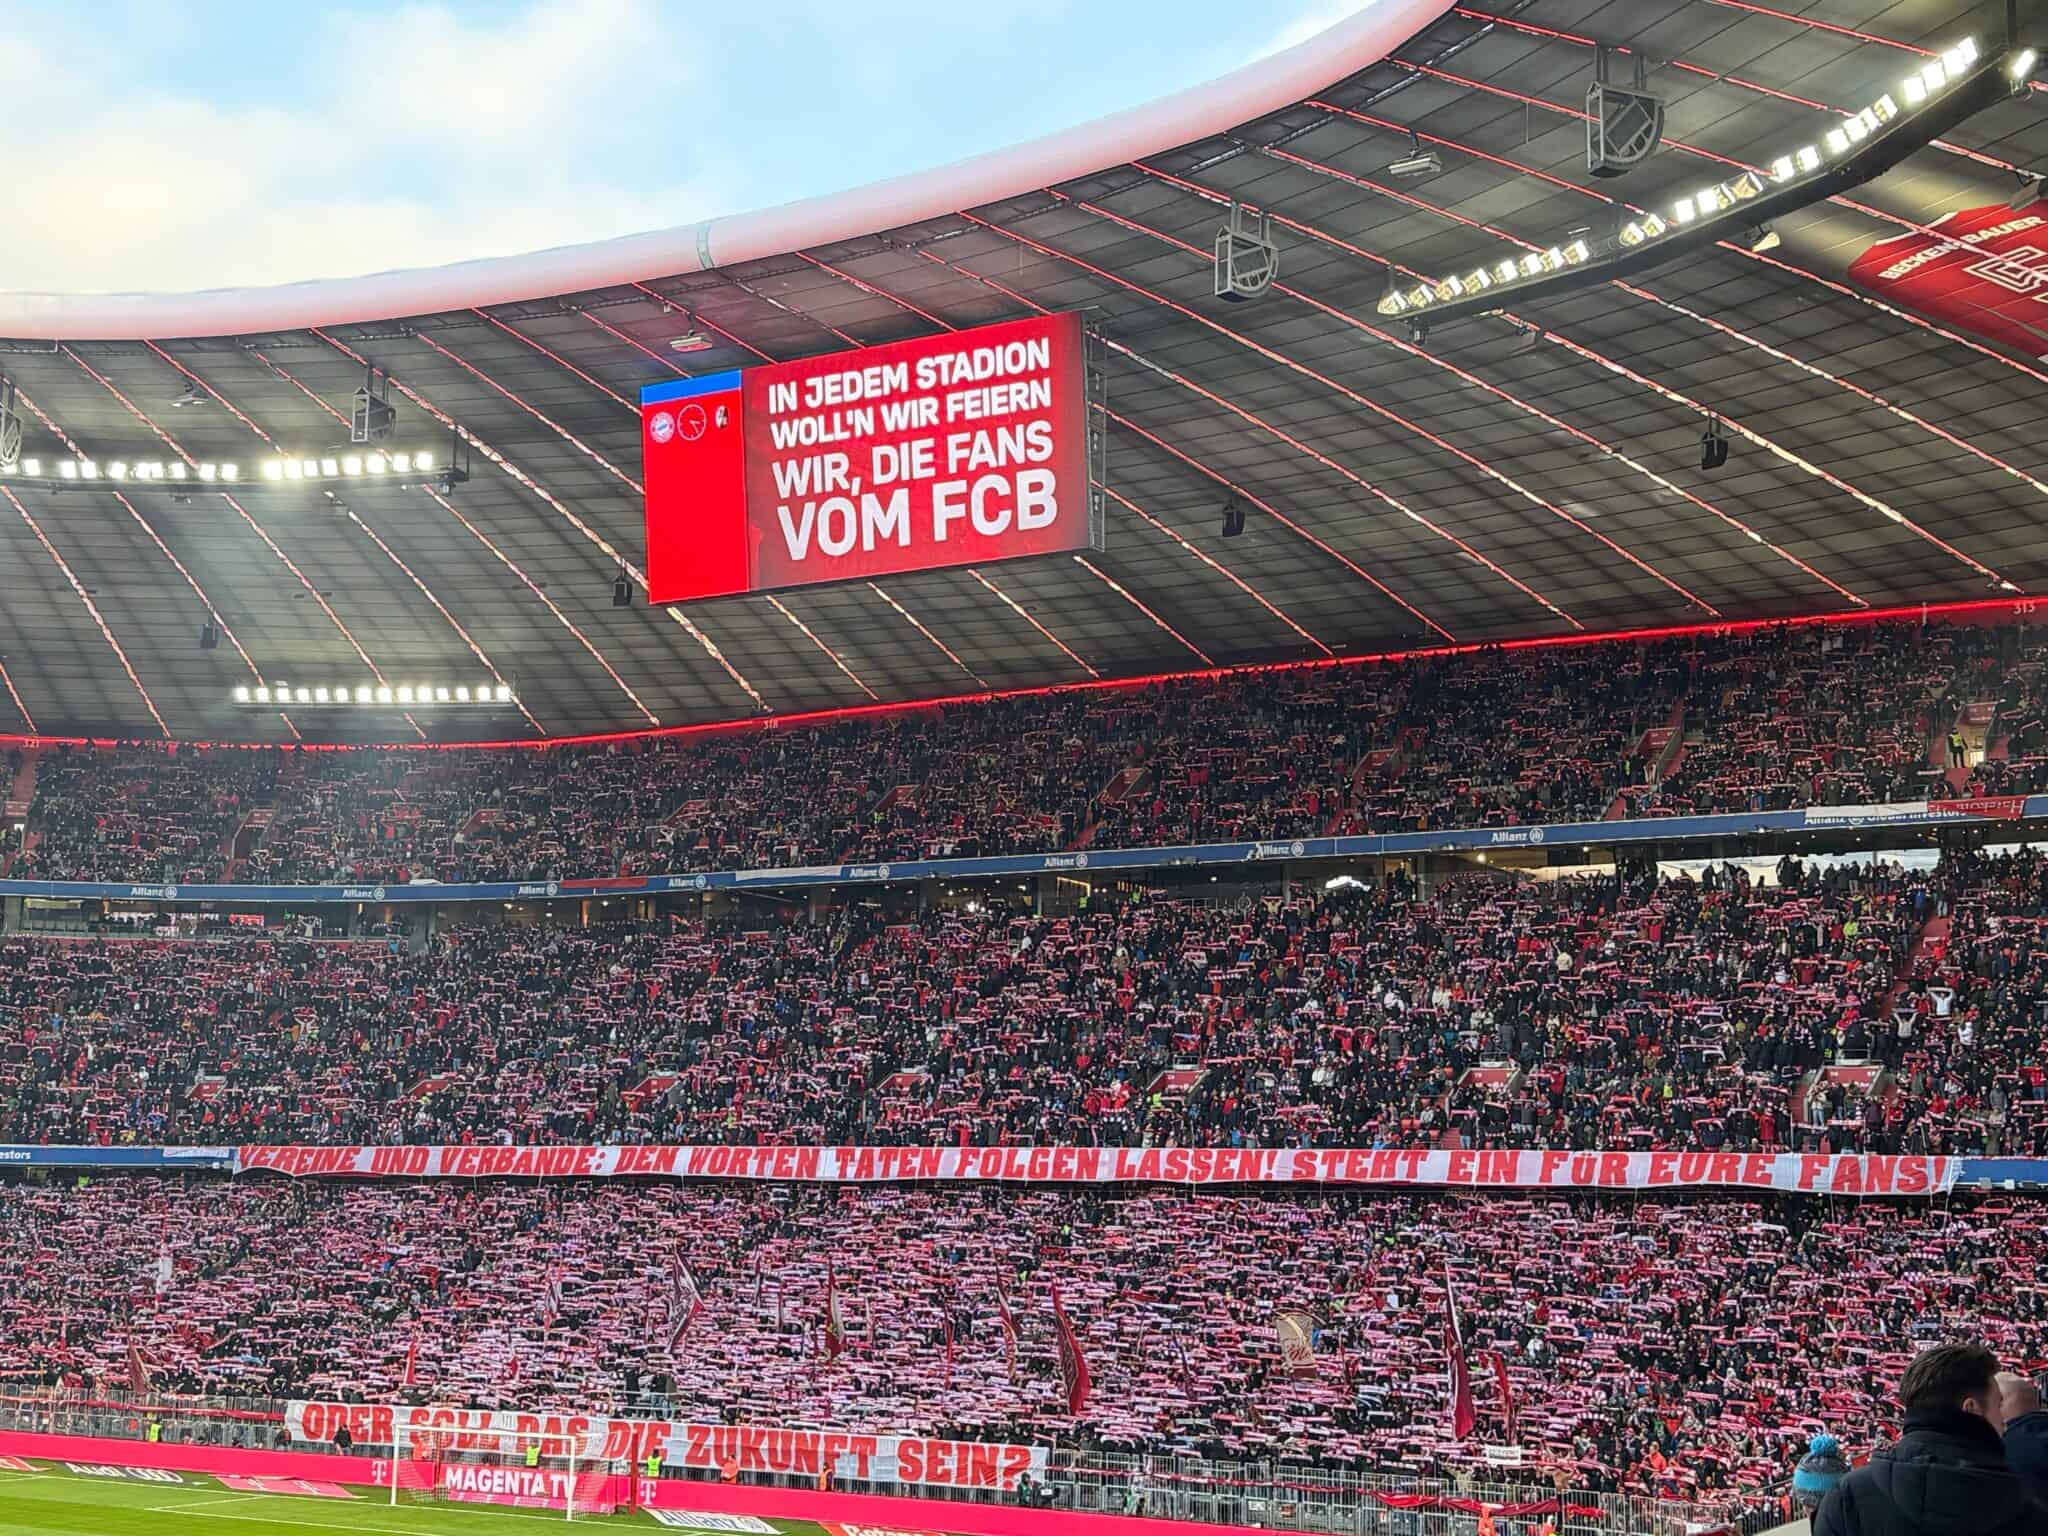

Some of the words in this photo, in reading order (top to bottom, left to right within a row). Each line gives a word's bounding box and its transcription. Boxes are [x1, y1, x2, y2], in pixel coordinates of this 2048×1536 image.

[768, 383, 797, 415] IN
[805, 362, 909, 409] JEDEM
[916, 337, 1050, 388] STADION
[771, 407, 875, 450] WOLL'N
[882, 398, 939, 434] WIR
[946, 378, 1052, 423] FEIERN
[772, 455, 861, 499] WIR,
[872, 439, 934, 484] DIE
[947, 420, 1054, 474] FANS
[777, 488, 911, 561] VOM
[932, 468, 1059, 543] FCB
[1491, 829, 1529, 843] Allianz
[1255, 842, 1290, 858] Allianz
[1044, 856, 1075, 868] Allianz
[849, 867, 877, 879] Allianz
[130, 886, 164, 898] Allianz
[518, 885, 546, 896] Allianz
[668, 877, 695, 889] Allianz
[342, 888, 373, 899] Allianz
[238, 1145, 361, 1175] VEREINE
[371, 1146, 430, 1175] UND
[615, 1146, 686, 1174] DEN
[688, 1146, 820, 1179] WORTEN
[835, 1147, 944, 1179] TATEN
[953, 1148, 1099, 1180] FOLGEN
[1114, 1148, 1278, 1182] LASSEN!
[1292, 1149, 1429, 1181] STEHT
[1446, 1151, 1520, 1184] EIN
[1538, 1152, 1632, 1186] FÜR
[1647, 1152, 1776, 1186] EURE
[1798, 1154, 1949, 1193] FANS!
[301, 1403, 395, 1444] ODER
[408, 1405, 501, 1450] SOLL
[515, 1413, 590, 1457] DAS
[600, 1420, 672, 1463] DIE
[684, 1424, 877, 1478] ZUKUNFT
[897, 1439, 1033, 1490] SEIN?
[445, 1467, 546, 1496] MAGENTA
[550, 1474, 579, 1499] TV
[659, 1508, 747, 1529] Allianz
